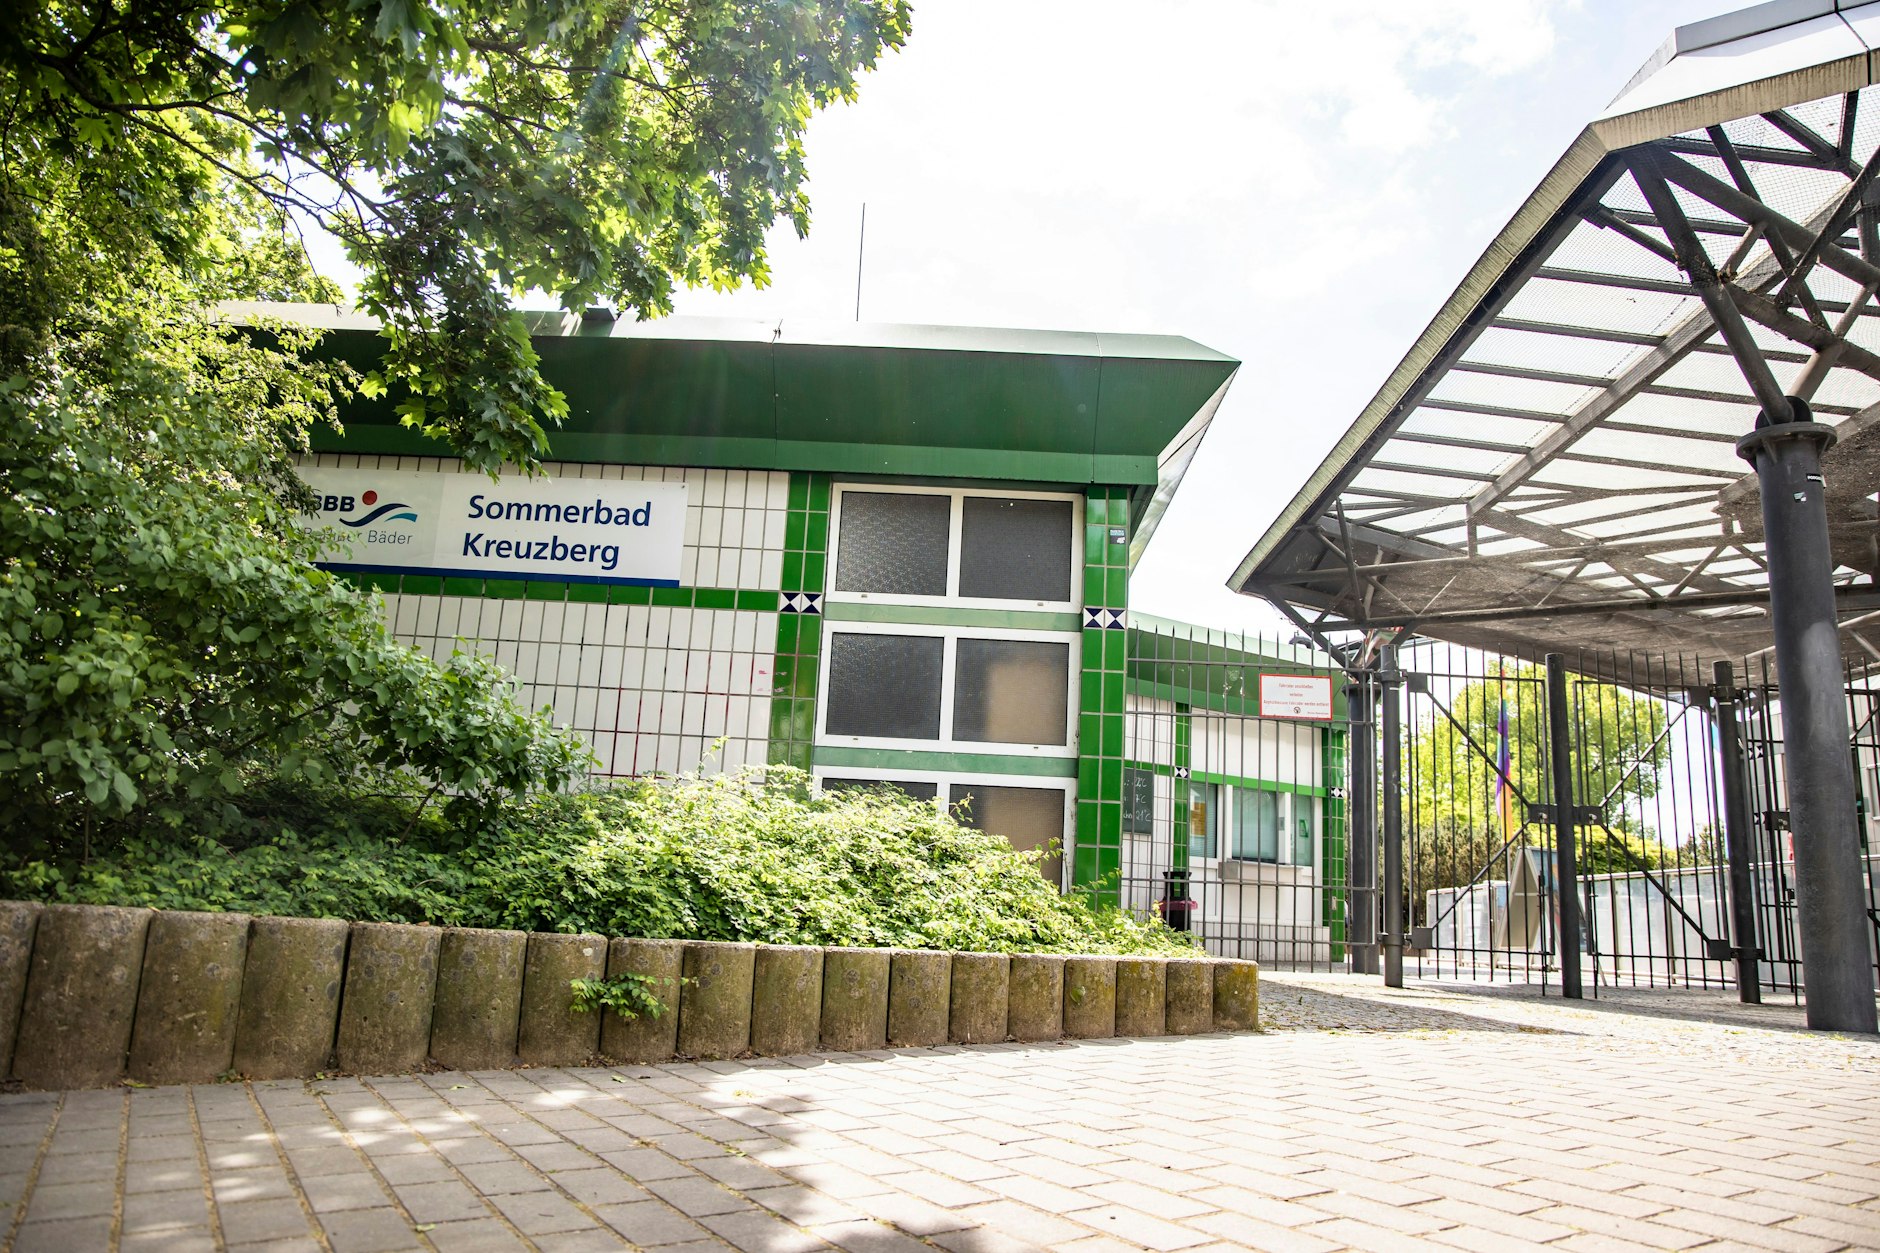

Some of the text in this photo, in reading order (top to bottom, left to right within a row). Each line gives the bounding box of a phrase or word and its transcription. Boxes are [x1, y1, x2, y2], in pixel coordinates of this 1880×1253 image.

[468, 495, 651, 526] Sommerbad
[368, 530, 413, 545] Bäder
[463, 532, 620, 569] Kreuzberg
